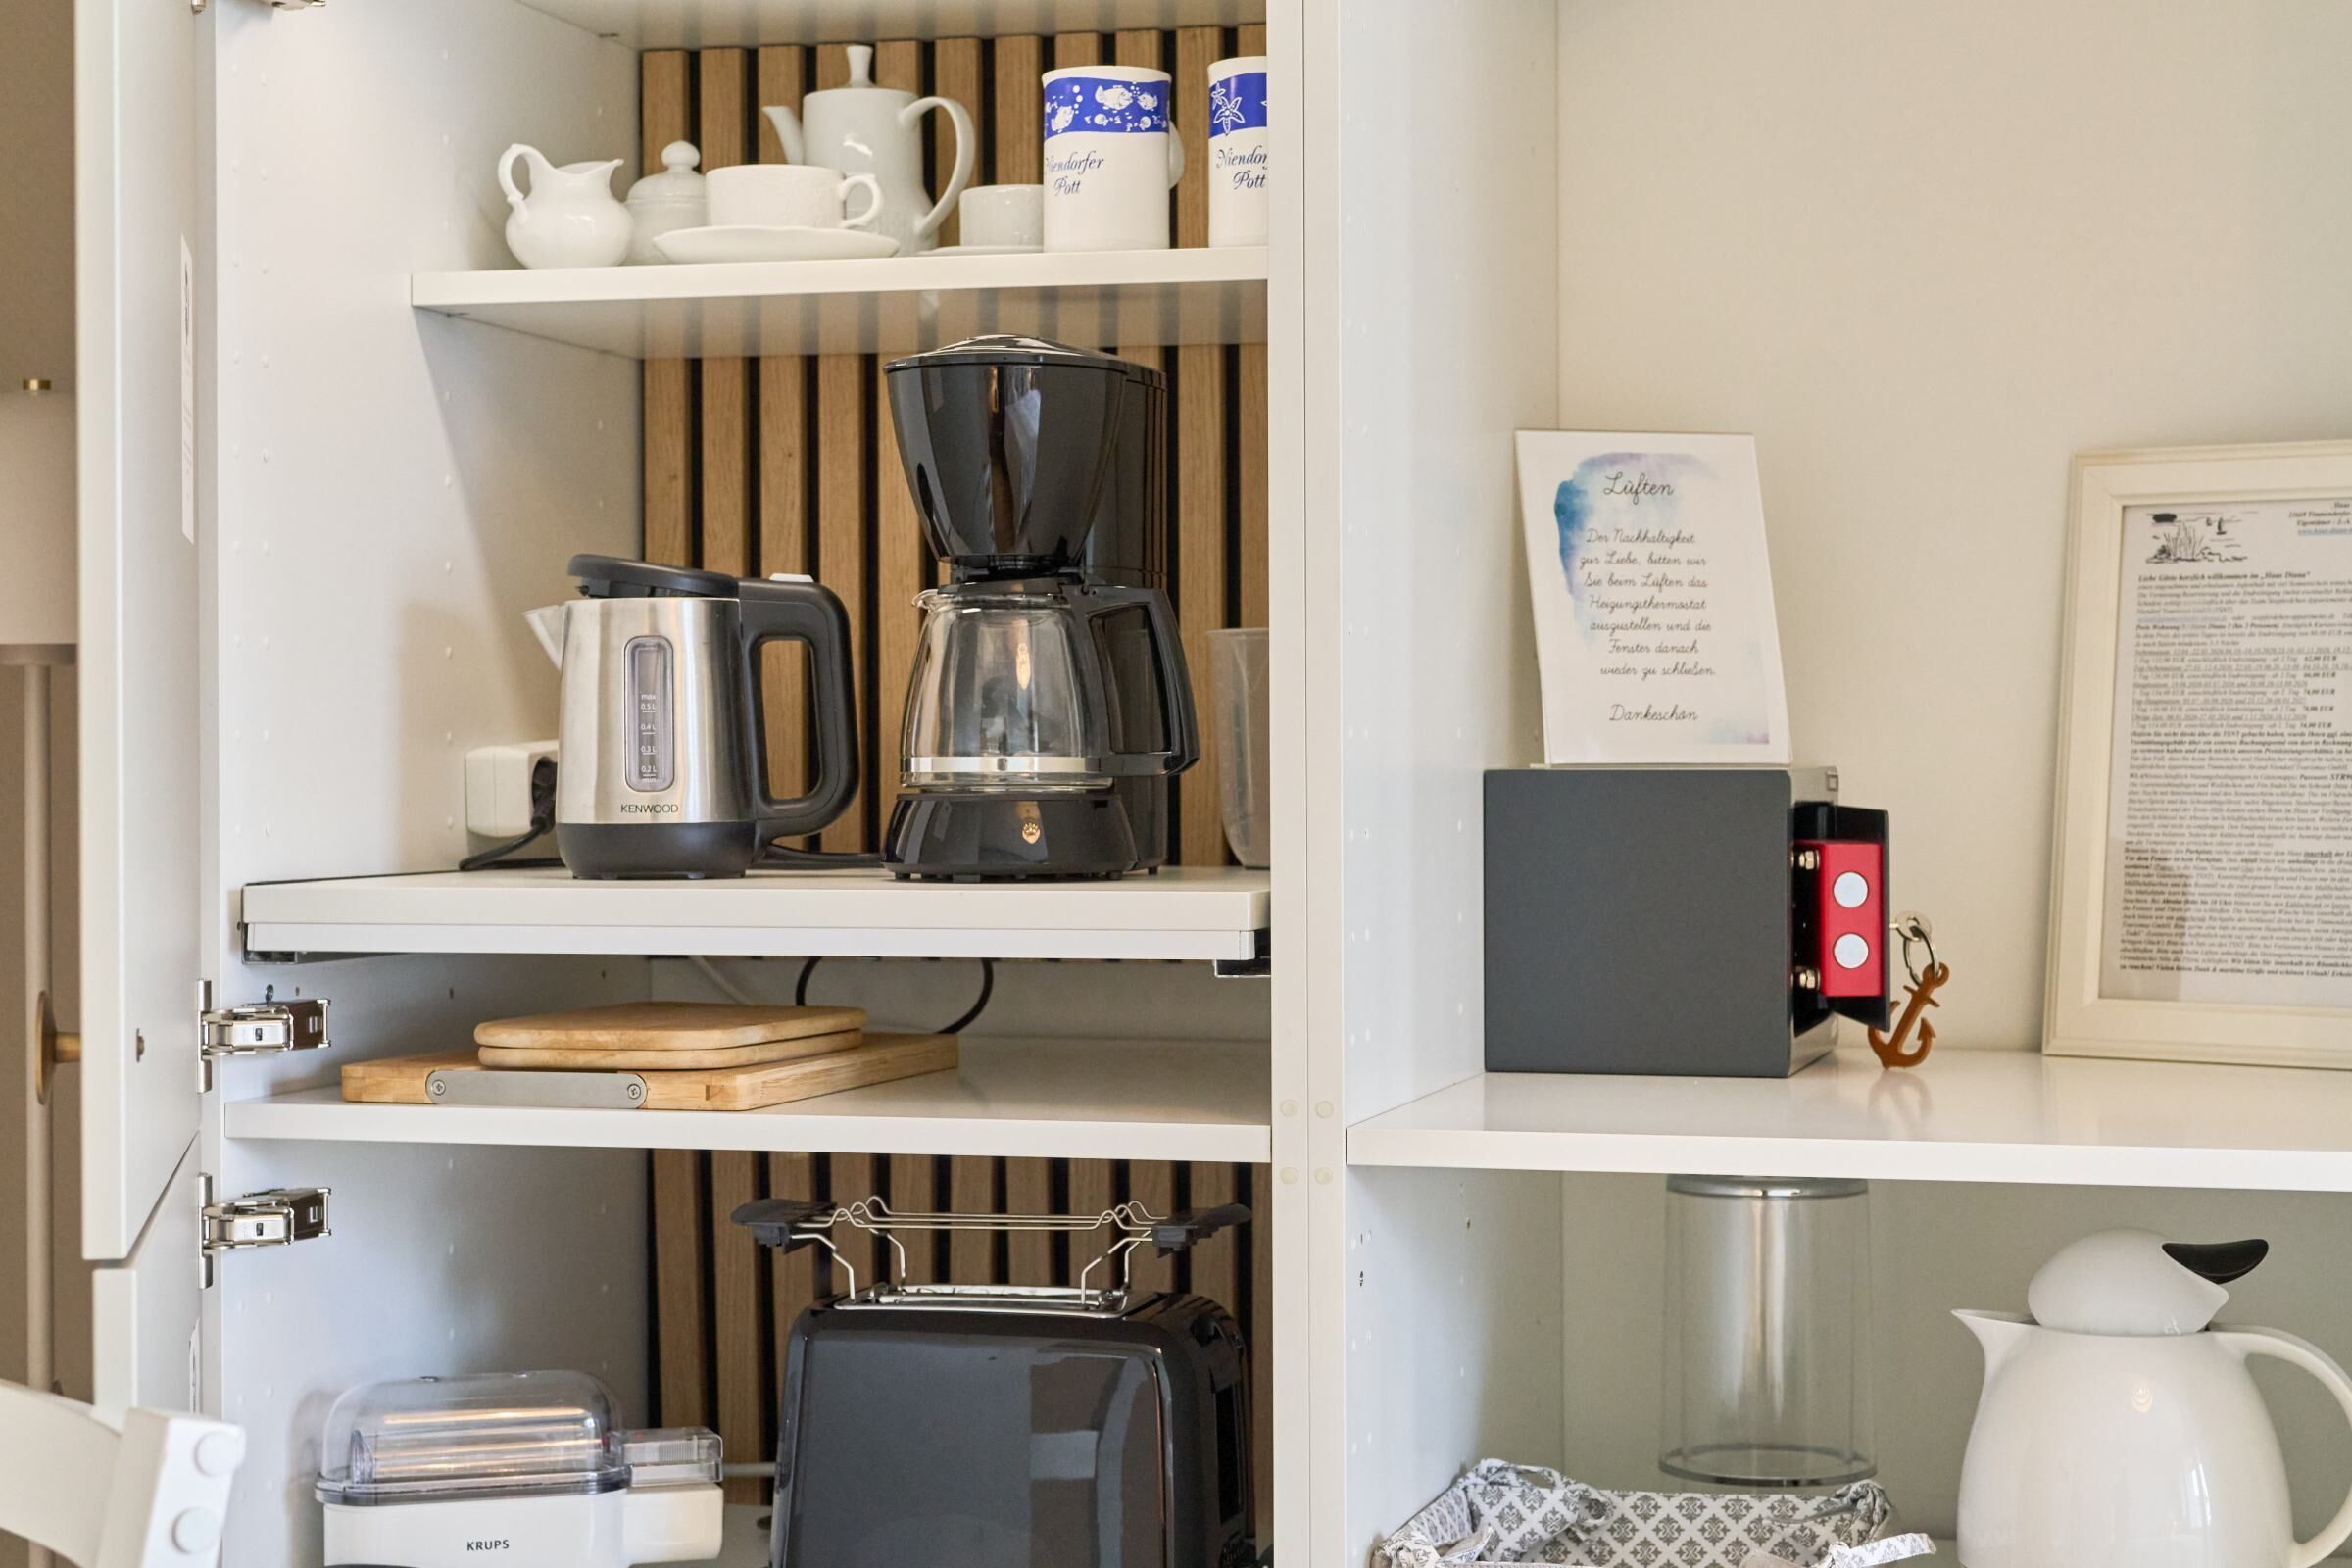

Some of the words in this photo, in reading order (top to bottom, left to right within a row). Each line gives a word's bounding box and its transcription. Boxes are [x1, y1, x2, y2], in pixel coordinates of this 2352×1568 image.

[1054, 176, 1081, 196] Pott
[1233, 170, 1266, 190] Pott
[1604, 471, 1674, 505] Lüften
[1586, 528, 1608, 543] Der
[1613, 528, 1695, 549] Nachhaltigkeit
[1580, 557, 1599, 570] zur
[1605, 550, 1642, 566] Liebe,
[1647, 551, 1682, 565] bitten
[1687, 556, 1707, 566] wir
[1584, 572, 1603, 587] Sie
[1608, 572, 1637, 587] beim
[1641, 572, 1684, 593] Lüften
[1688, 575, 1709, 588] das
[1589, 594, 1707, 614] Heizungsthermostat
[1590, 616, 1662, 637] auszustellen
[1666, 619, 1691, 631] und
[1695, 619, 1712, 631] die
[1608, 639, 1652, 654] Fenster
[1655, 639, 1699, 654] danach
[1600, 662, 1638, 675] wieder
[1642, 667, 1656, 681] zu
[1608, 704, 1699, 721] Dankeschön
[620, 804, 679, 813] KENWOOD
[466, 1539, 510, 1552] KRUPS
